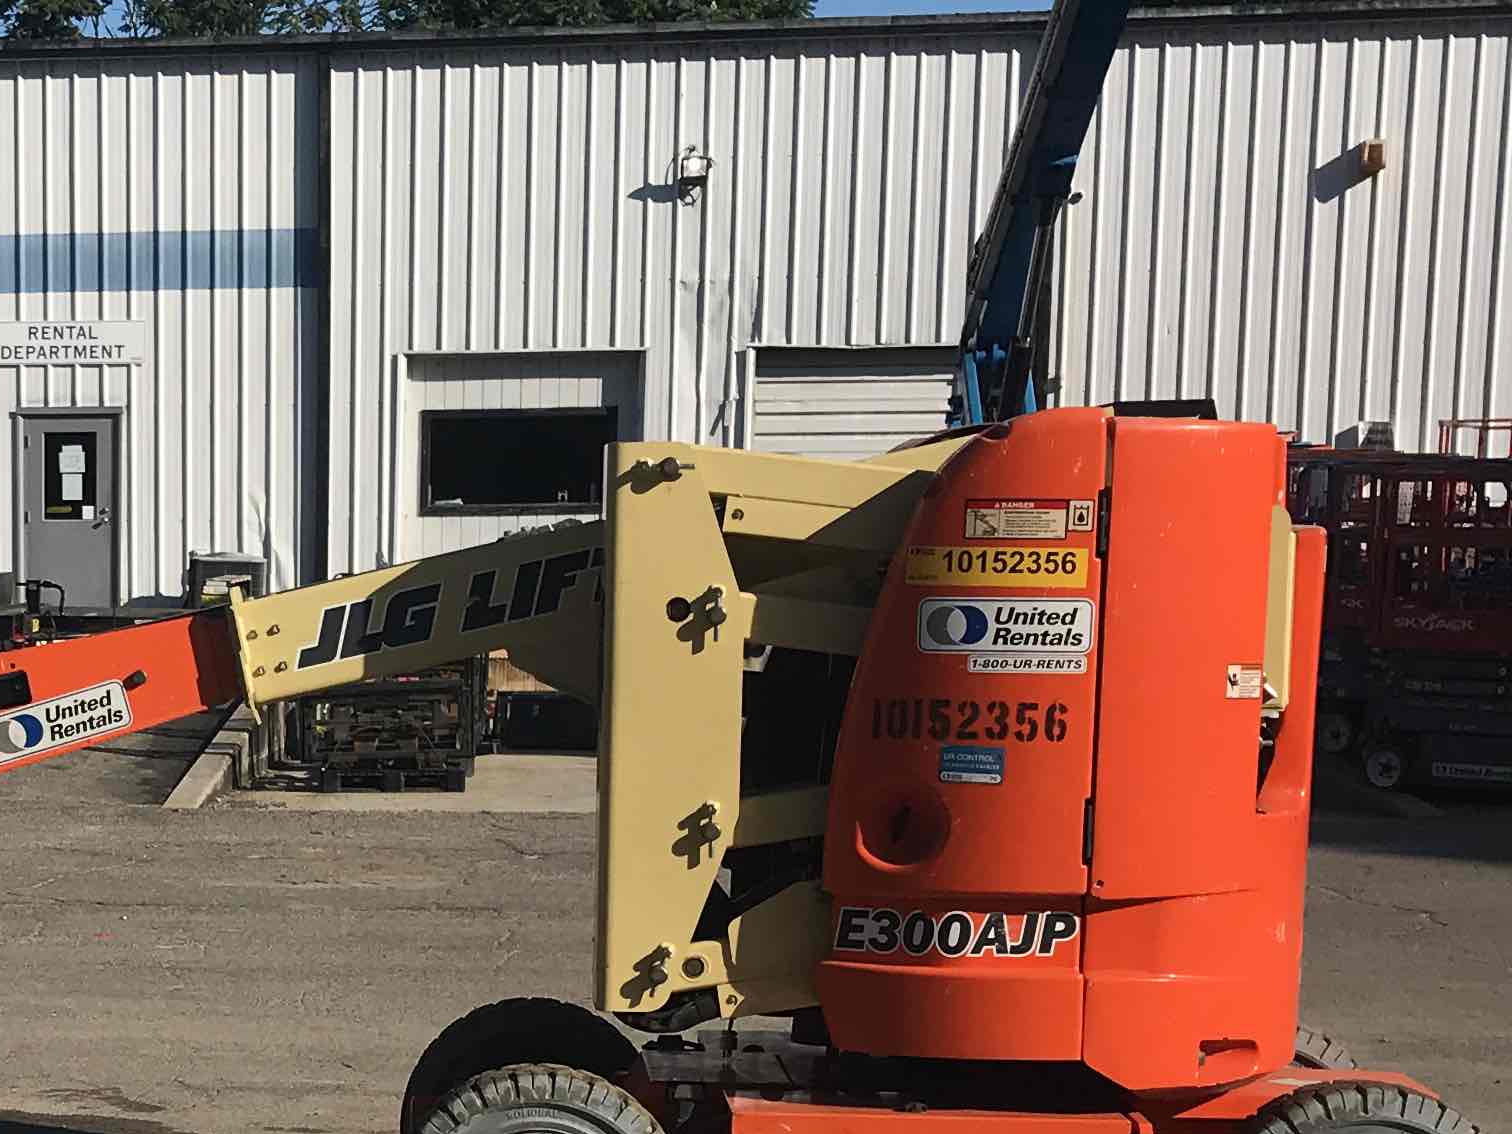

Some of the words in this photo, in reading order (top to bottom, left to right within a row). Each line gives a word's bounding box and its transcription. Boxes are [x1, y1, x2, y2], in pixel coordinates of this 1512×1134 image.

[28, 325, 99, 340] RENTAL
[0, 344, 126, 360] DEPARTMENT
[942, 550, 1077, 575] 10152356
[296, 583, 444, 672] JLG
[994, 606, 1079, 626] United
[991, 627, 1084, 647] Rentals
[971, 659, 1083, 670] 1-800-UR-RENTS
[45, 689, 112, 723] United
[50, 708, 124, 742] Rentals
[871, 698, 1069, 743] 10152356
[834, 906, 1081, 958] E300AJP
